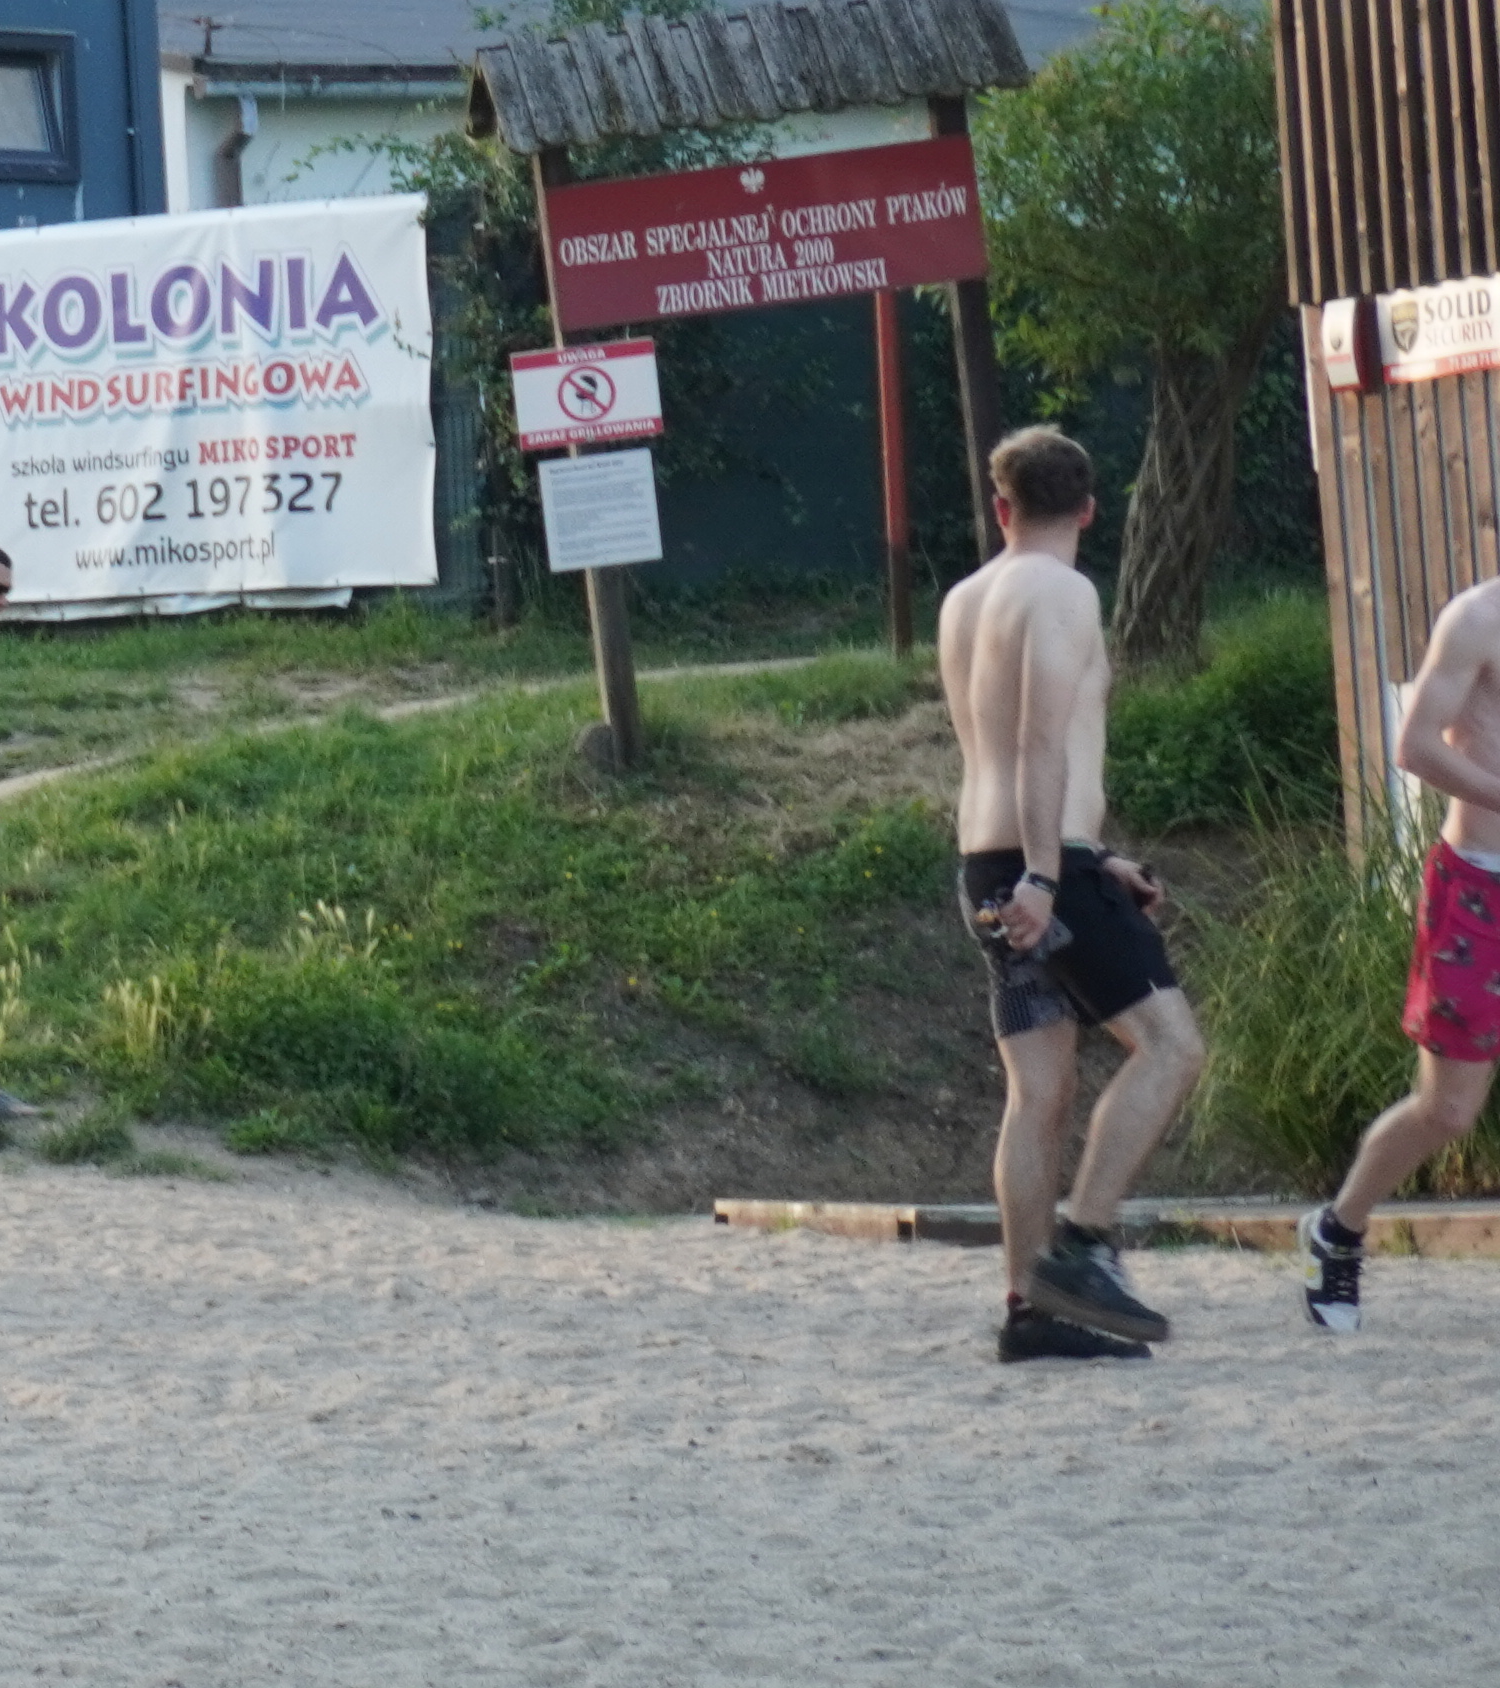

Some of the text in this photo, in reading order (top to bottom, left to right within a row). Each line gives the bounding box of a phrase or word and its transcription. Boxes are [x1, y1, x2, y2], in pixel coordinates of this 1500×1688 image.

[560, 181, 967, 266] OBSZAR SPECJALNEJ OCHRONY PTAKÓW
[706, 236, 835, 278] NATURA 2000
[656, 257, 889, 314] ZBIORNIK MIETKOWSKI
[1424, 290, 1492, 324] SOLID
[1426, 320, 1494, 348] SECURITY
[0, 359, 362, 419] WINDSURFINGOWA
[11, 454, 66, 478] szkoła
[73, 447, 190, 473] windsurfingu
[198, 438, 259, 465] MIKO
[265, 433, 357, 460] SPORT
[527, 428, 567, 445] ZAKAZ
[24, 472, 343, 529] tel. 602 197 327
[75, 531, 276, 570] www.mikosport.pl
